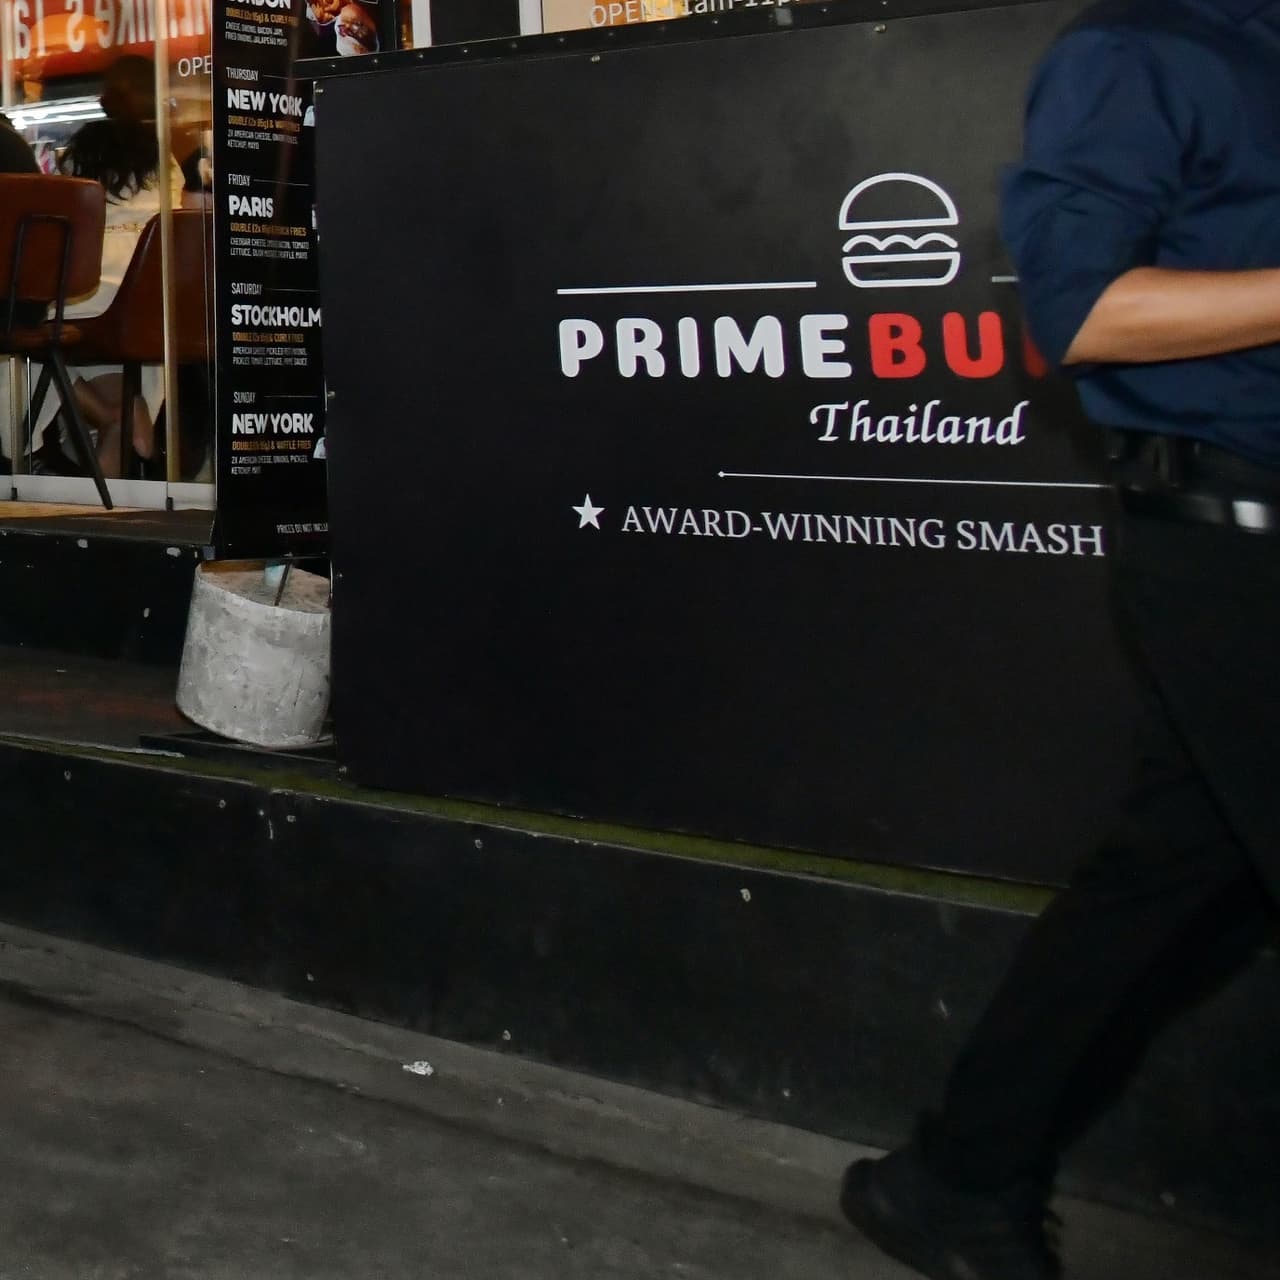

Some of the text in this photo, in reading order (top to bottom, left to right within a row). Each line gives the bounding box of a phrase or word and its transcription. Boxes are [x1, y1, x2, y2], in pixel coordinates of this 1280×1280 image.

[226, 67, 258, 81] THURSDAY
[227, 88, 302, 117] NEW YORK
[228, 174, 250, 186] FRIDAY
[229, 195, 273, 218] PARIS
[231, 282, 262, 295] SATURDAY
[231, 304, 322, 327] STOCKHOLM
[558, 311, 1047, 379] PRIMEBU
[233, 392, 256, 403] SUNDAY
[232, 413, 313, 434] NEW YORK
[810, 399, 1029, 445] Thailand
[621, 504, 1105, 556] AWARD-WINNING SMASH
